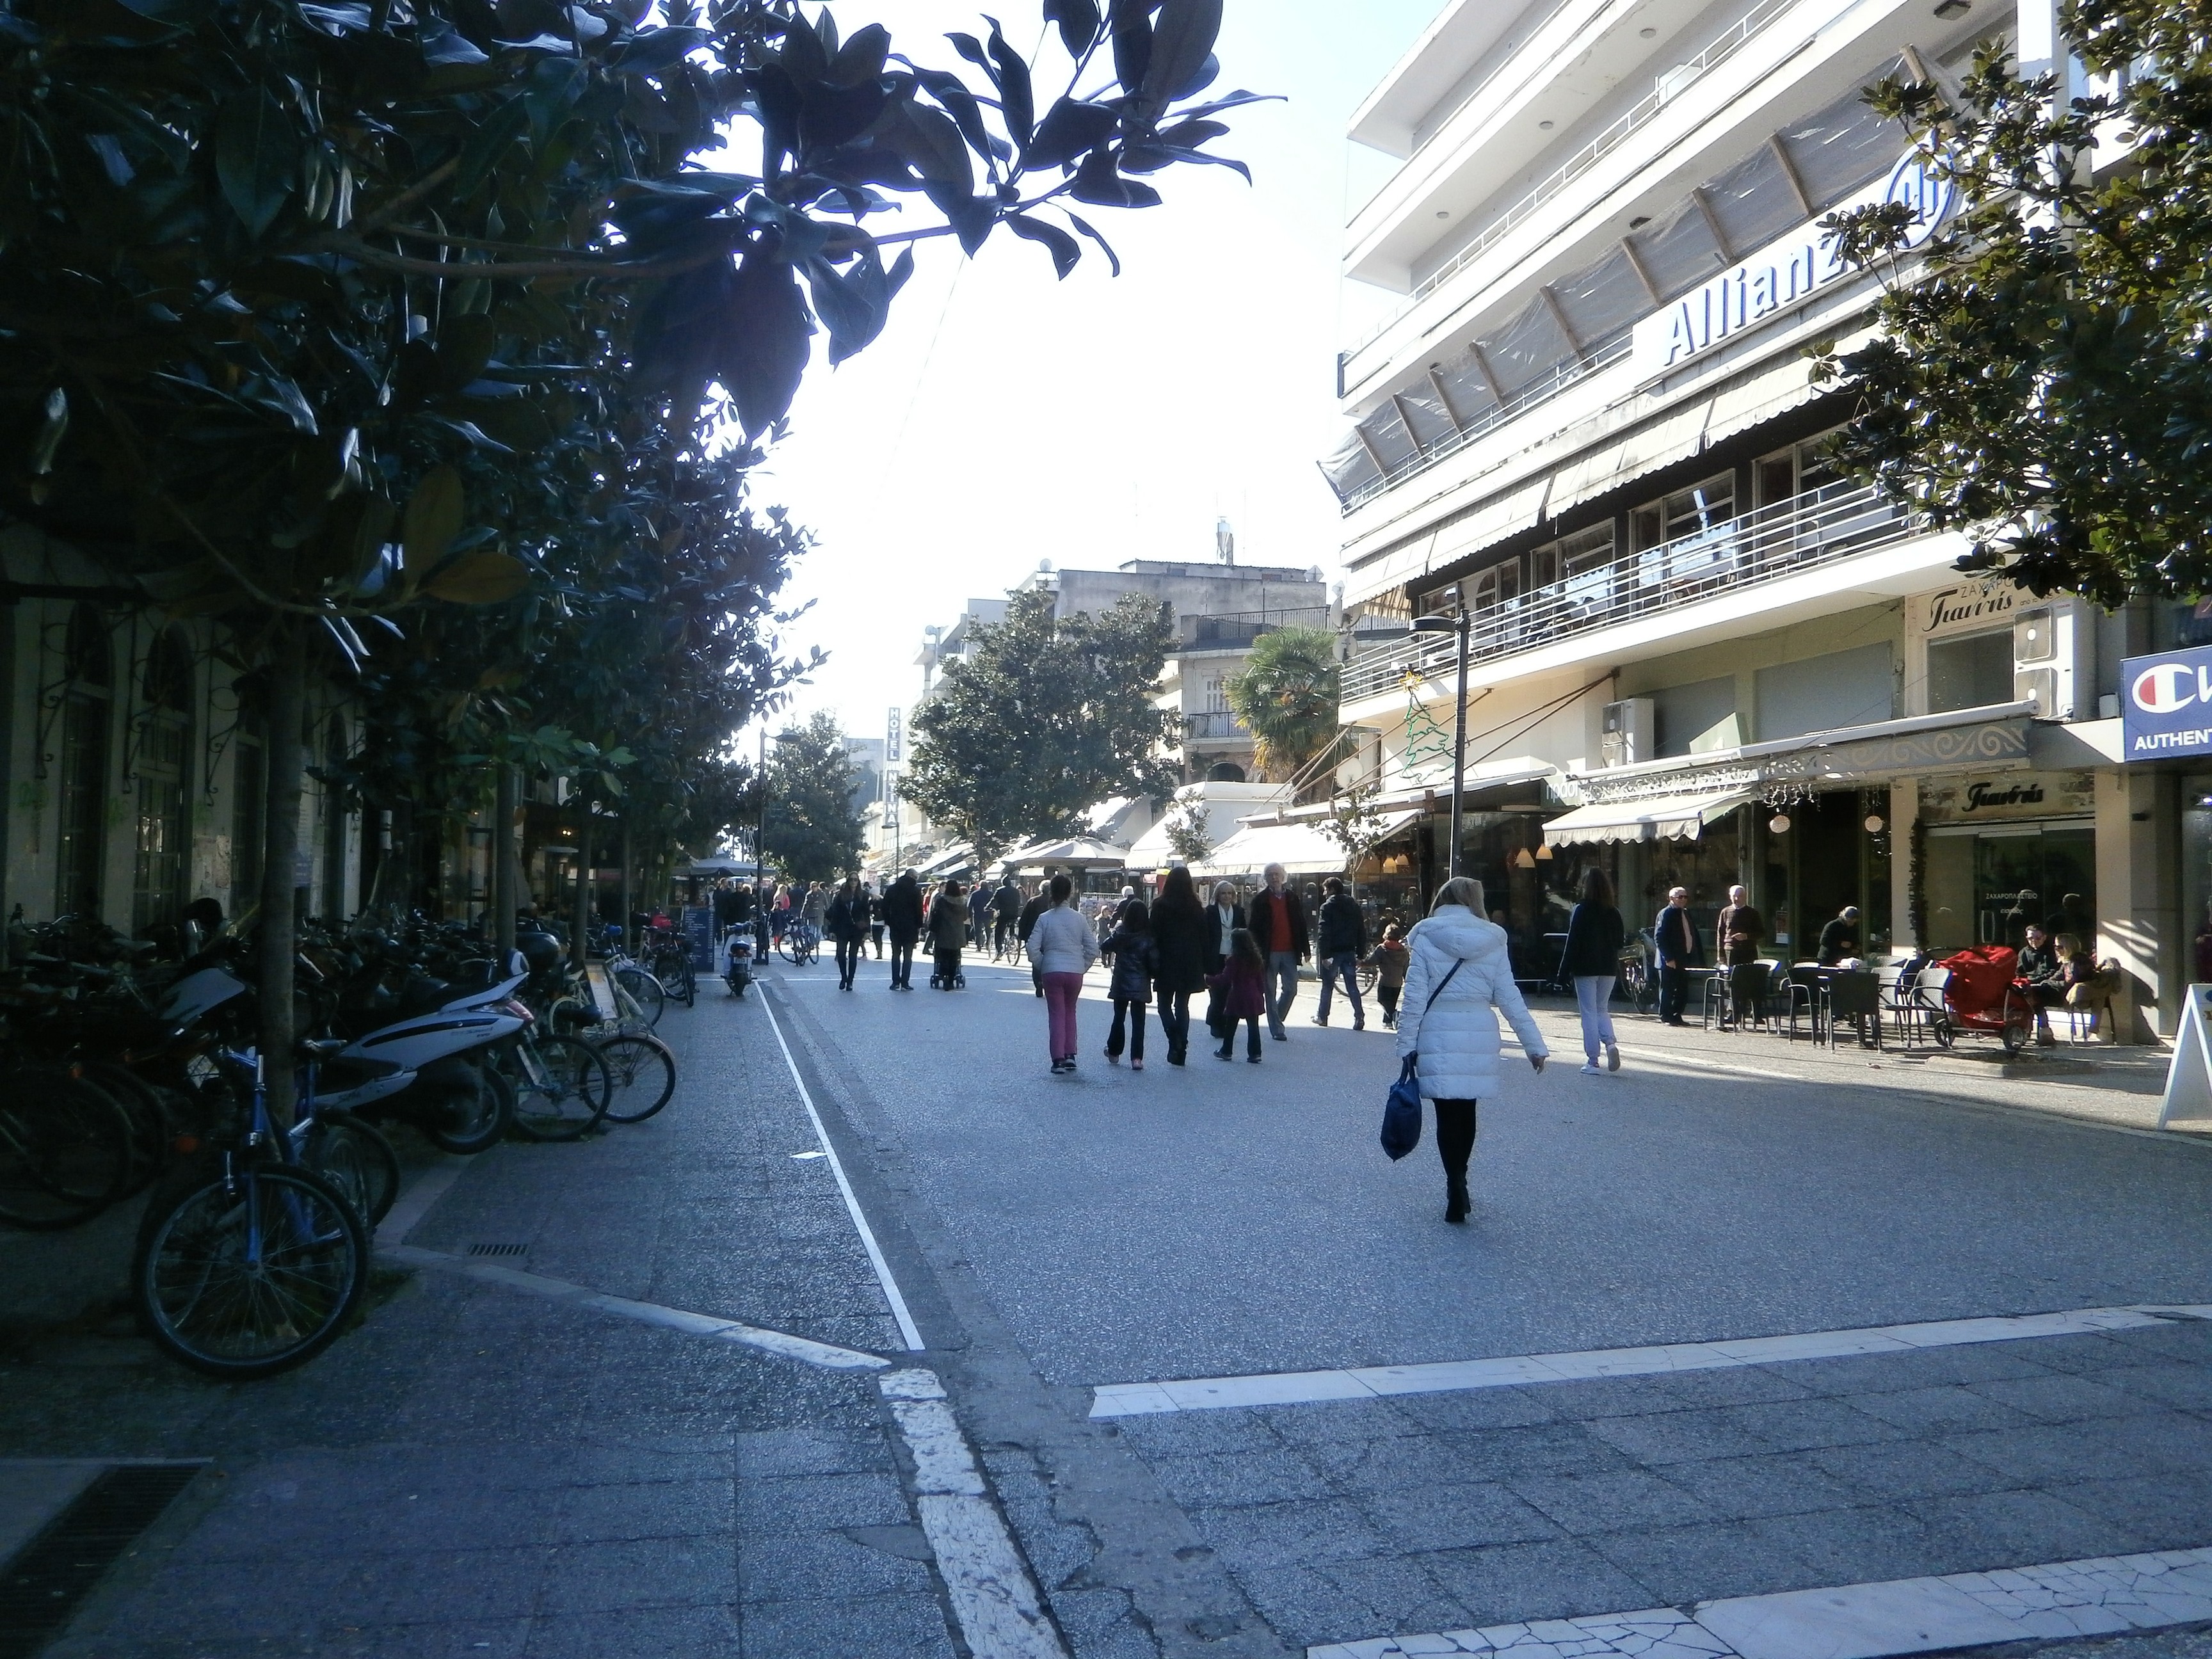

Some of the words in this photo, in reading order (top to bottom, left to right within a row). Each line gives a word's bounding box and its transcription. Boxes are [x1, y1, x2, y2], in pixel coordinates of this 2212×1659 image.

[1663, 233, 1850, 366] Allianz
[890, 708, 899, 760] HOTEL
[887, 774, 897, 823] NTINA
